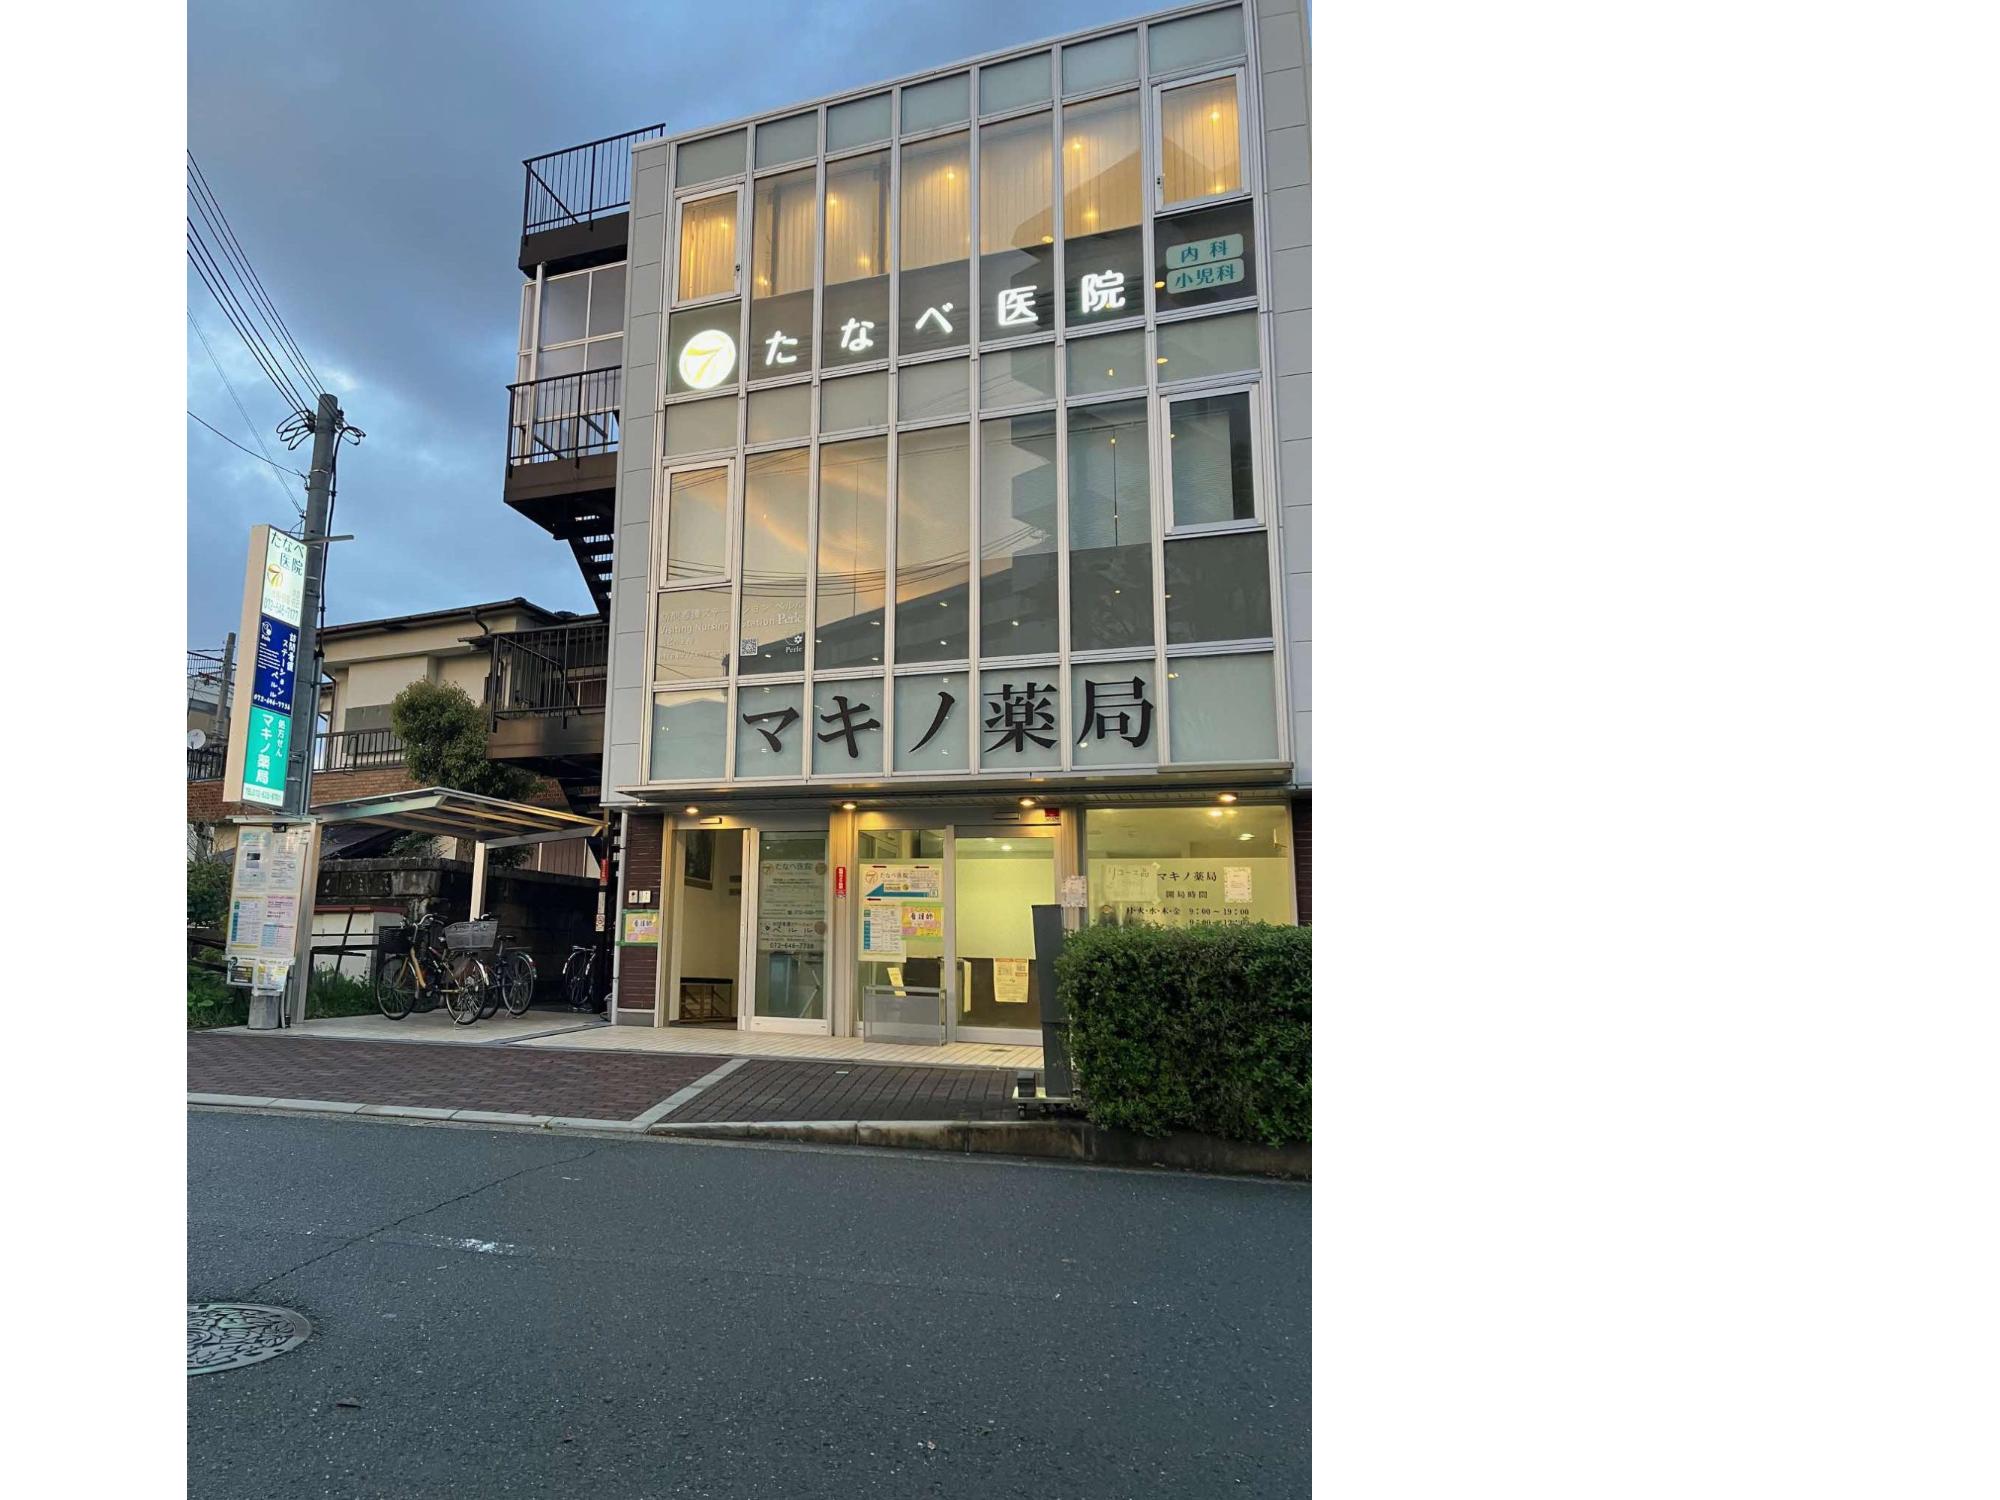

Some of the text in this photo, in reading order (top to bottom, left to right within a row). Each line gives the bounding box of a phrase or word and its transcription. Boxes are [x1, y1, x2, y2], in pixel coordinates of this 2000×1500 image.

[1181, 240, 1228, 263] 内科
[1175, 264, 1235, 288] 小児科
[765, 271, 1127, 366] たなべ医院
[271, 532, 304, 559] たなべ
[280, 552, 303, 577] 医院
[784, 645, 803, 654] Perle
[742, 675, 1155, 759] マキノ薬局
[255, 713, 274, 785] マキノ薬局
[1157, 871, 1217, 882] マキノ薬局
[1165, 891, 1208, 900] 開局時間
